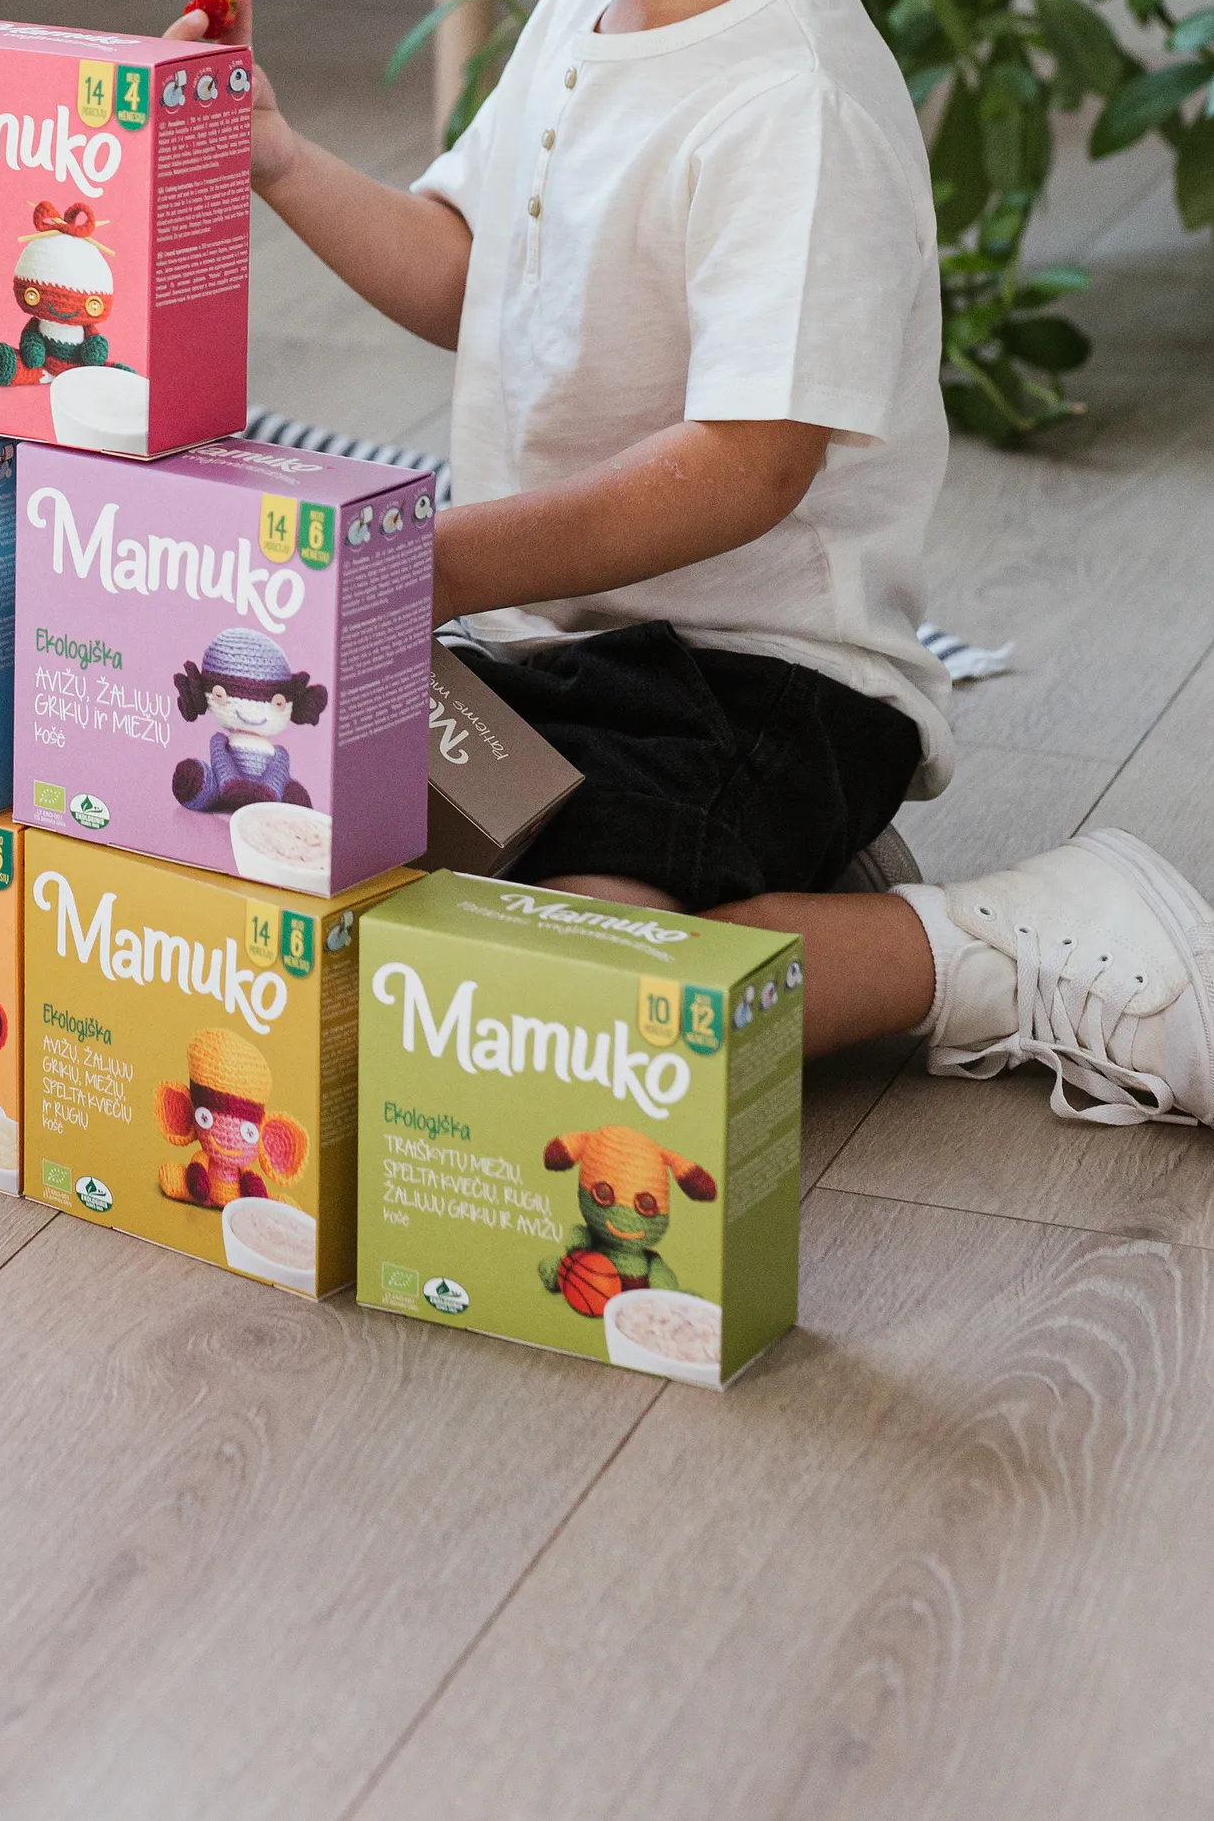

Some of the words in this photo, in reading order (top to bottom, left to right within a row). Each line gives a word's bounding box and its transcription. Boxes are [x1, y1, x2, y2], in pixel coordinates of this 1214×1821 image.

[85, 76, 104, 105] 14
[124, 81, 140, 112] 4
[187, 442, 323, 473] amuko
[267, 511, 288, 541] 14
[308, 520, 324, 550] 6
[26, 487, 305, 633] Mamuko
[36, 627, 123, 670] Ekologiška
[96, 675, 171, 722] ŽALIŲJŲ
[34, 693, 89, 729] GRIKIŲ
[94, 706, 108, 730] ir
[112, 711, 171, 748] MIEŽIŲ
[34, 721, 66, 748] košė
[452, 700, 509, 760] Patiems
[252, 916, 271, 947] 14
[499, 893, 688, 944] Mamuko
[33, 870, 288, 1035] Mamuko
[290, 929, 304, 958] 6
[43, 1003, 112, 1045] Ekologiška
[648, 993, 670, 1024] 10
[690, 1001, 714, 1035] 12
[371, 961, 690, 1121] Mamuko
[83, 1046, 134, 1083] ŽALIŲJŲ
[42, 1077, 87, 1107] SPELTA
[87, 1091, 132, 1124] KVIEČIŲ
[54, 1099, 89, 1130] RUGIŲ
[383, 1101, 472, 1141] Ekologiška
[383, 1158, 439, 1190] SPELTA
